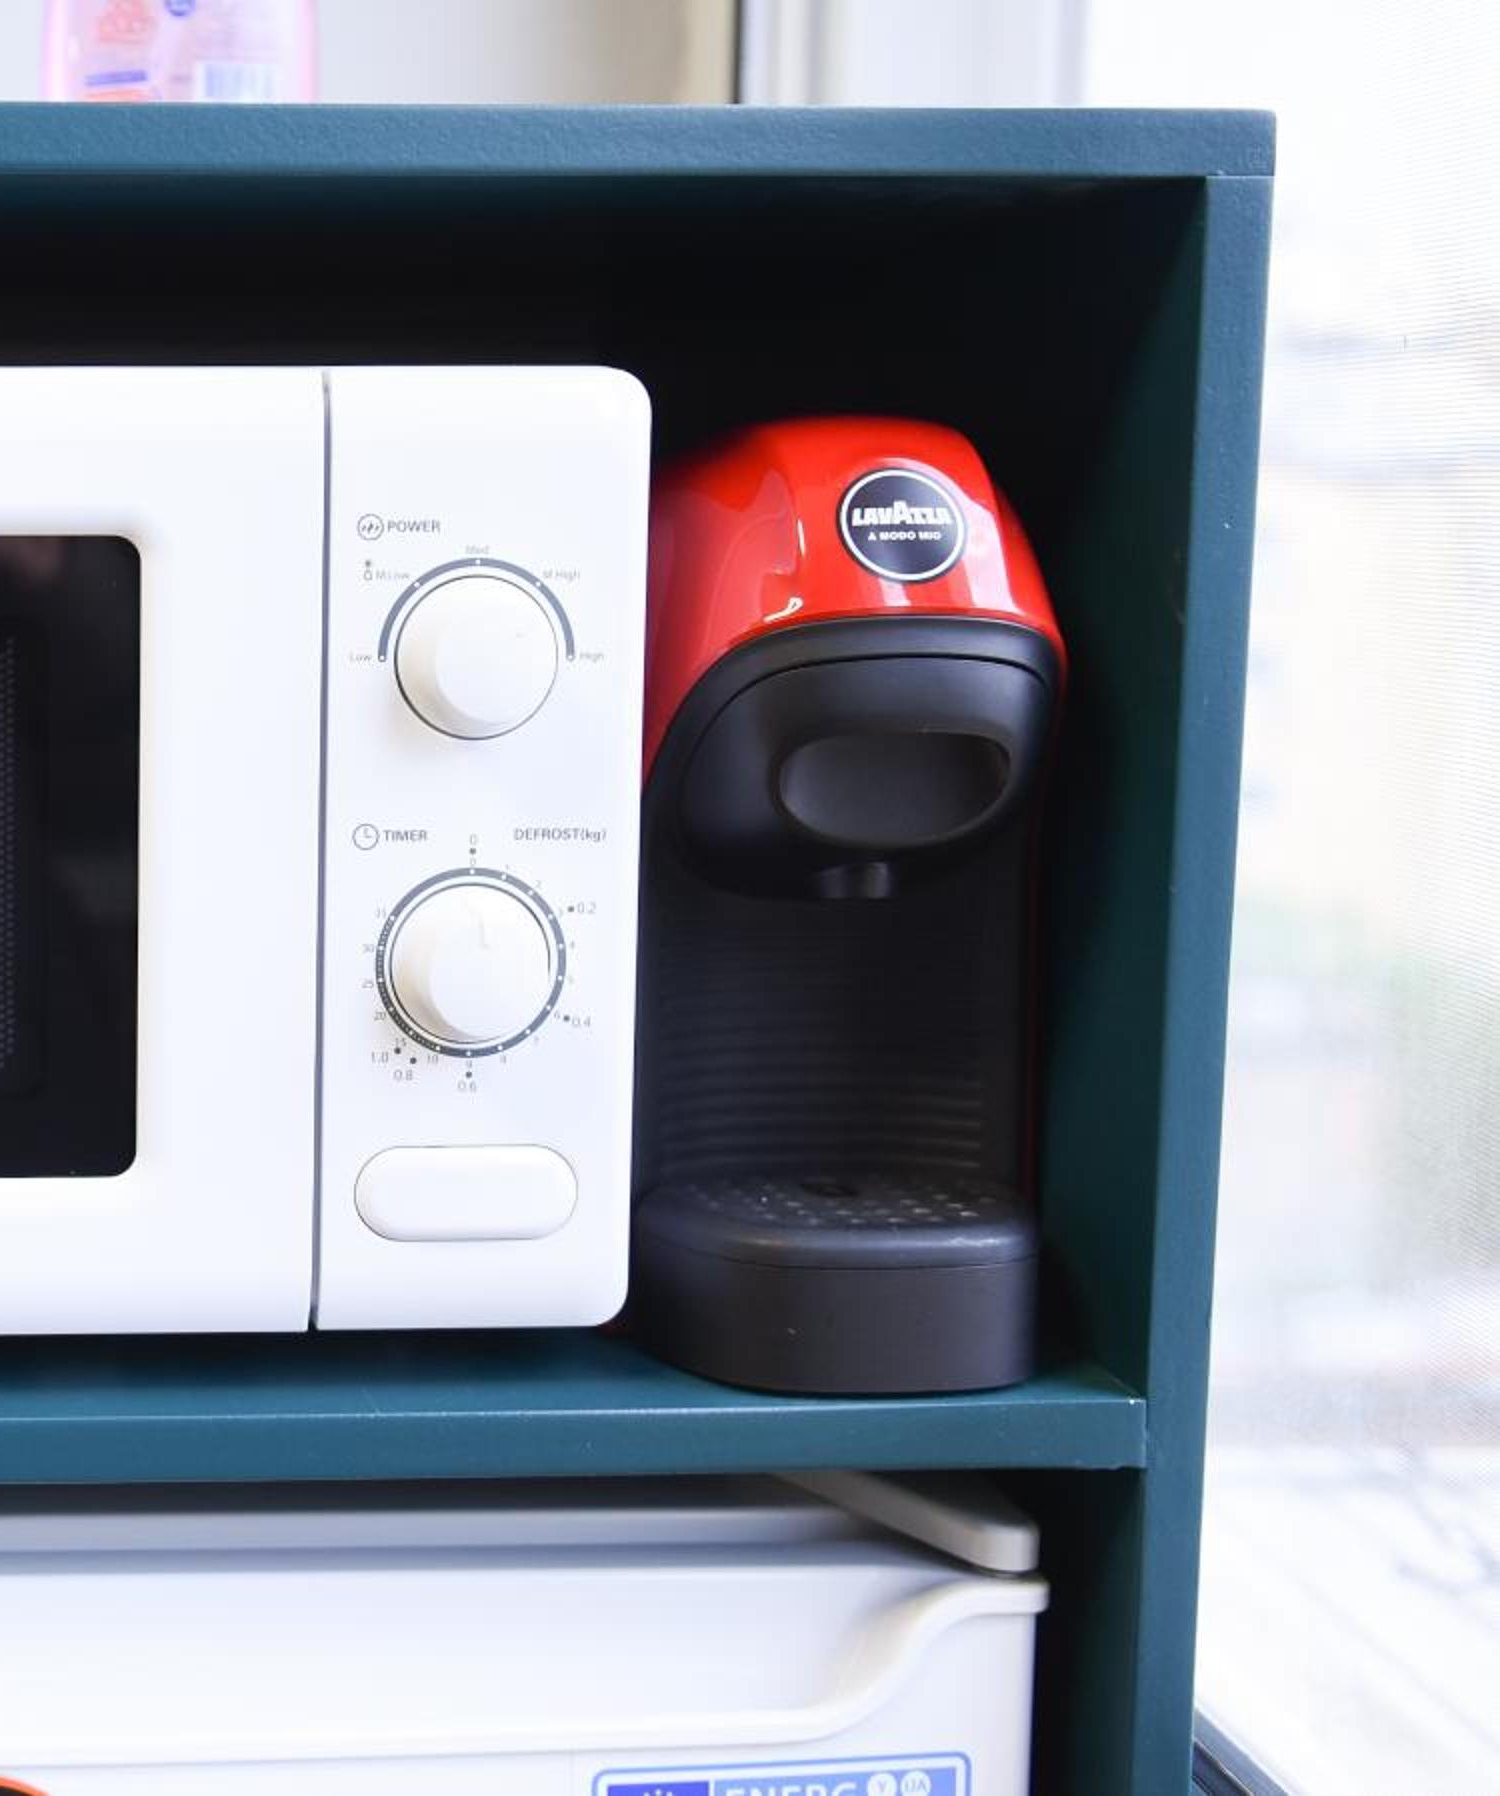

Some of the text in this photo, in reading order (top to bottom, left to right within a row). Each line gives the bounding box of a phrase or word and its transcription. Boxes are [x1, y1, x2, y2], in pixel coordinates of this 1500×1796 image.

[852, 500, 952, 526] LAVAZZA
[387, 519, 441, 533] POWER
[868, 531, 942, 541] A MODO MIO
[350, 652, 372, 663] Low
[383, 829, 427, 842] TIMER
[513, 827, 607, 843] DEFROST(kg)
